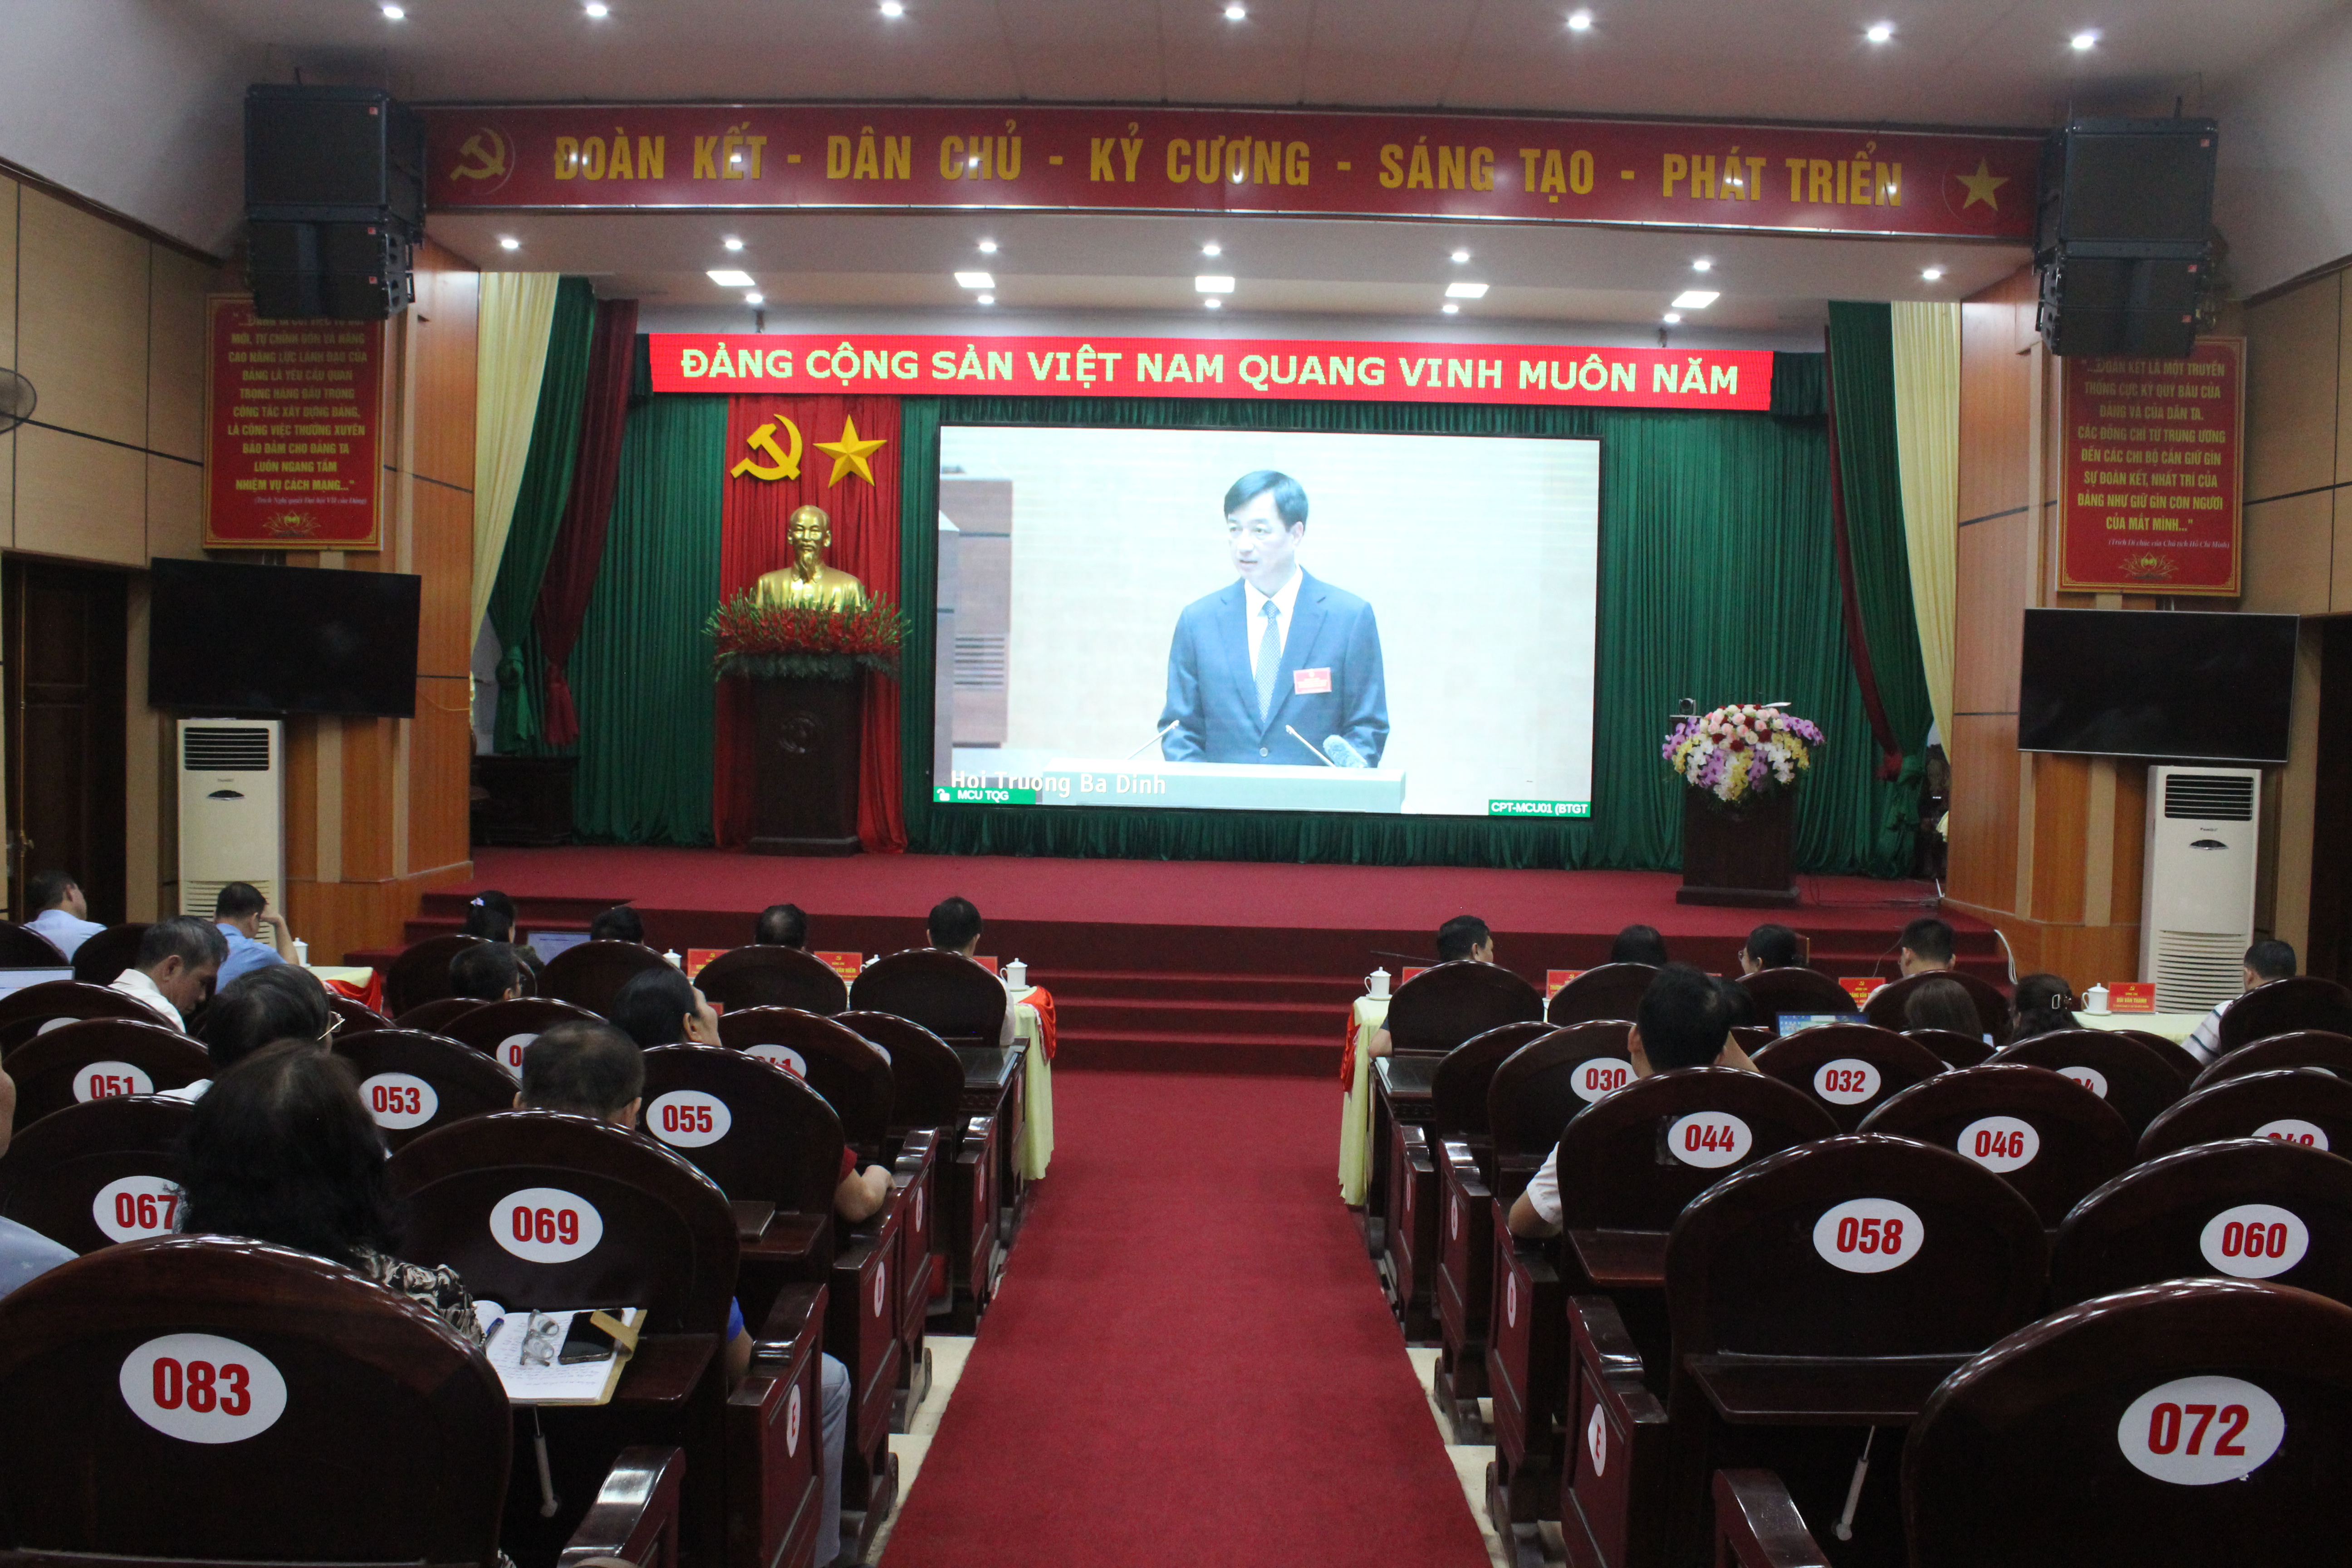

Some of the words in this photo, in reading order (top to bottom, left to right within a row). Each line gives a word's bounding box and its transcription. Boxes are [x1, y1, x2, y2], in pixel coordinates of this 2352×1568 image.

[554, 127, 665, 180] ĐOÀN
[694, 122, 767, 180] KẾT
[827, 127, 911, 180] DÂN
[940, 122, 1021, 180] CHỦ
[1091, 122, 1143, 182] KỶ
[1167, 136, 1309, 186] CƯƠNG
[1379, 145, 1494, 191] SÁNG
[1520, 149, 1593, 203] TẠO
[1663, 147, 1766, 201] PHÁT
[1786, 142, 1901, 206] TRIỂN
[681, 342, 792, 378] ĐẢNG
[806, 342, 918, 386] CỘNG
[932, 344, 1013, 381] SẢN
[1027, 344, 1122, 388] VIỆT
[1137, 353, 1224, 384] NAM
[1239, 355, 1385, 391] QUANG
[1399, 358, 1501, 388] VINH
[1519, 354, 1635, 392] MUÔN
[1652, 358, 1738, 394] NĂM
[951, 770, 986, 789] Hoi
[997, 772, 1070, 798] Truong
[1081, 774, 1107, 793] Ba
[1116, 774, 1166, 794] Dinh
[957, 790, 983, 801] MCU
[985, 790, 1009, 802] TQG
[1491, 802, 1553, 813] CPT-MCU01
[1554, 803, 1588, 816] (BTGT
[91, 1074, 133, 1099] 051
[1586, 1068, 1626, 1091] 030
[1826, 1070, 1865, 1092] 032
[373, 1086, 421, 1114] 053
[664, 1105, 712, 1132] 055
[1685, 1124, 1734, 1152] 044
[1975, 1130, 2024, 1158] 046
[116, 1192, 177, 1229] 067
[513, 1206, 578, 1245] 069
[1837, 1217, 1903, 1254] 058
[2222, 1222, 2287, 1258] 060
[153, 1357, 251, 1416] 083
[2148, 1402, 2249, 1456] 072
